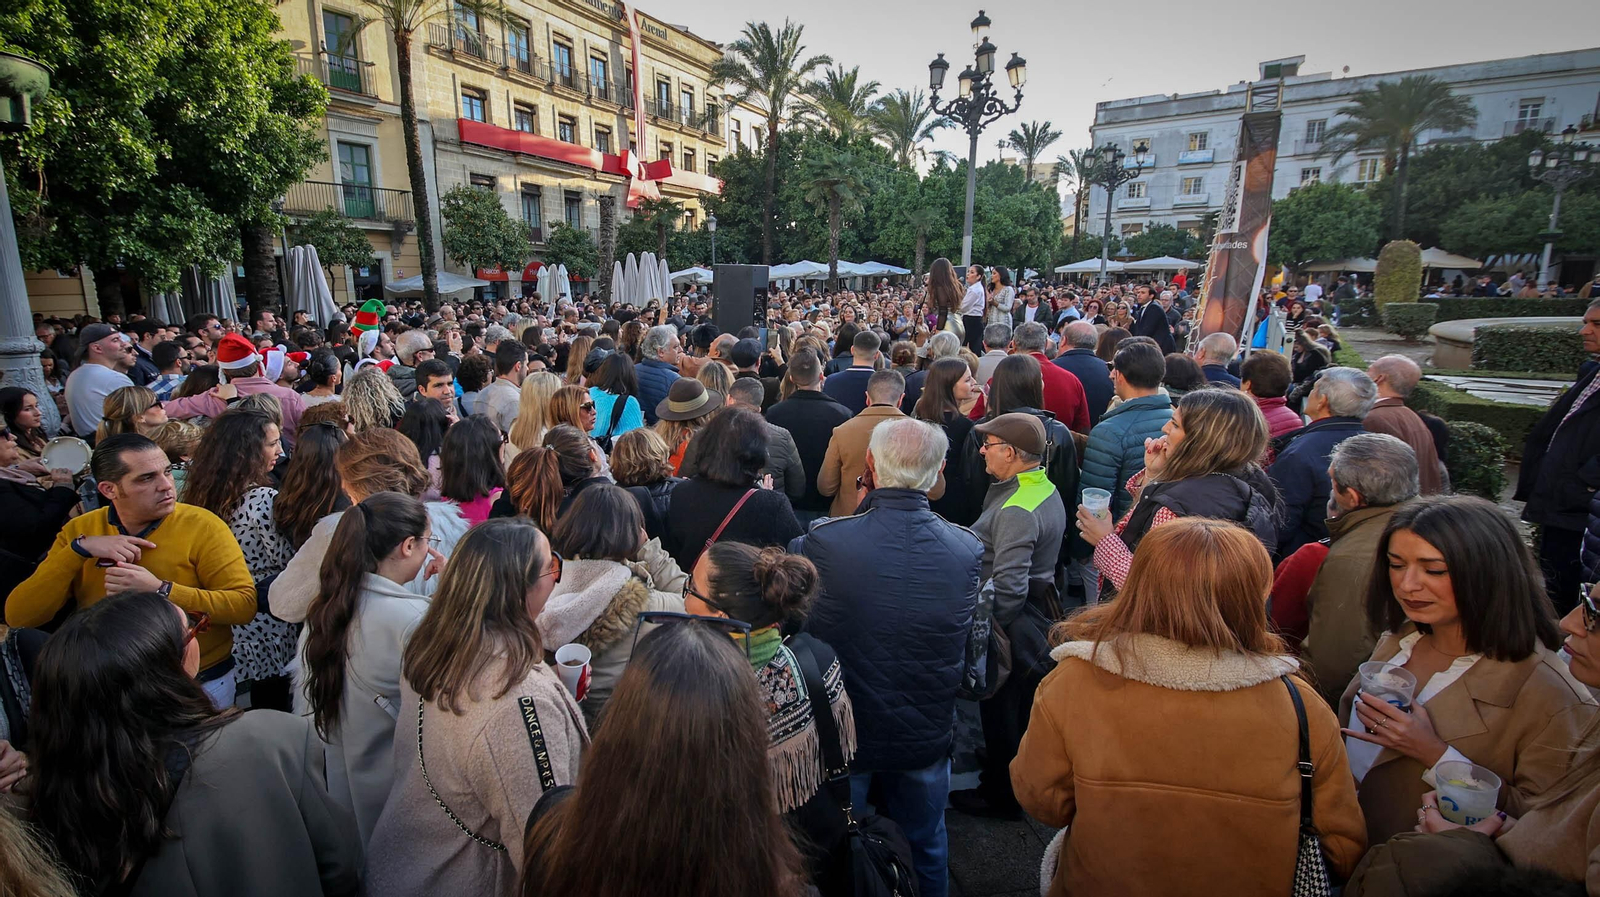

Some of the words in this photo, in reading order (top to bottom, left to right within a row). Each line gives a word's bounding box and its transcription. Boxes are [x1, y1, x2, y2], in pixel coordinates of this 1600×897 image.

[641, 18, 668, 40] Arenal
[521, 696, 541, 738] DANCE
[533, 739, 544, 749] &
